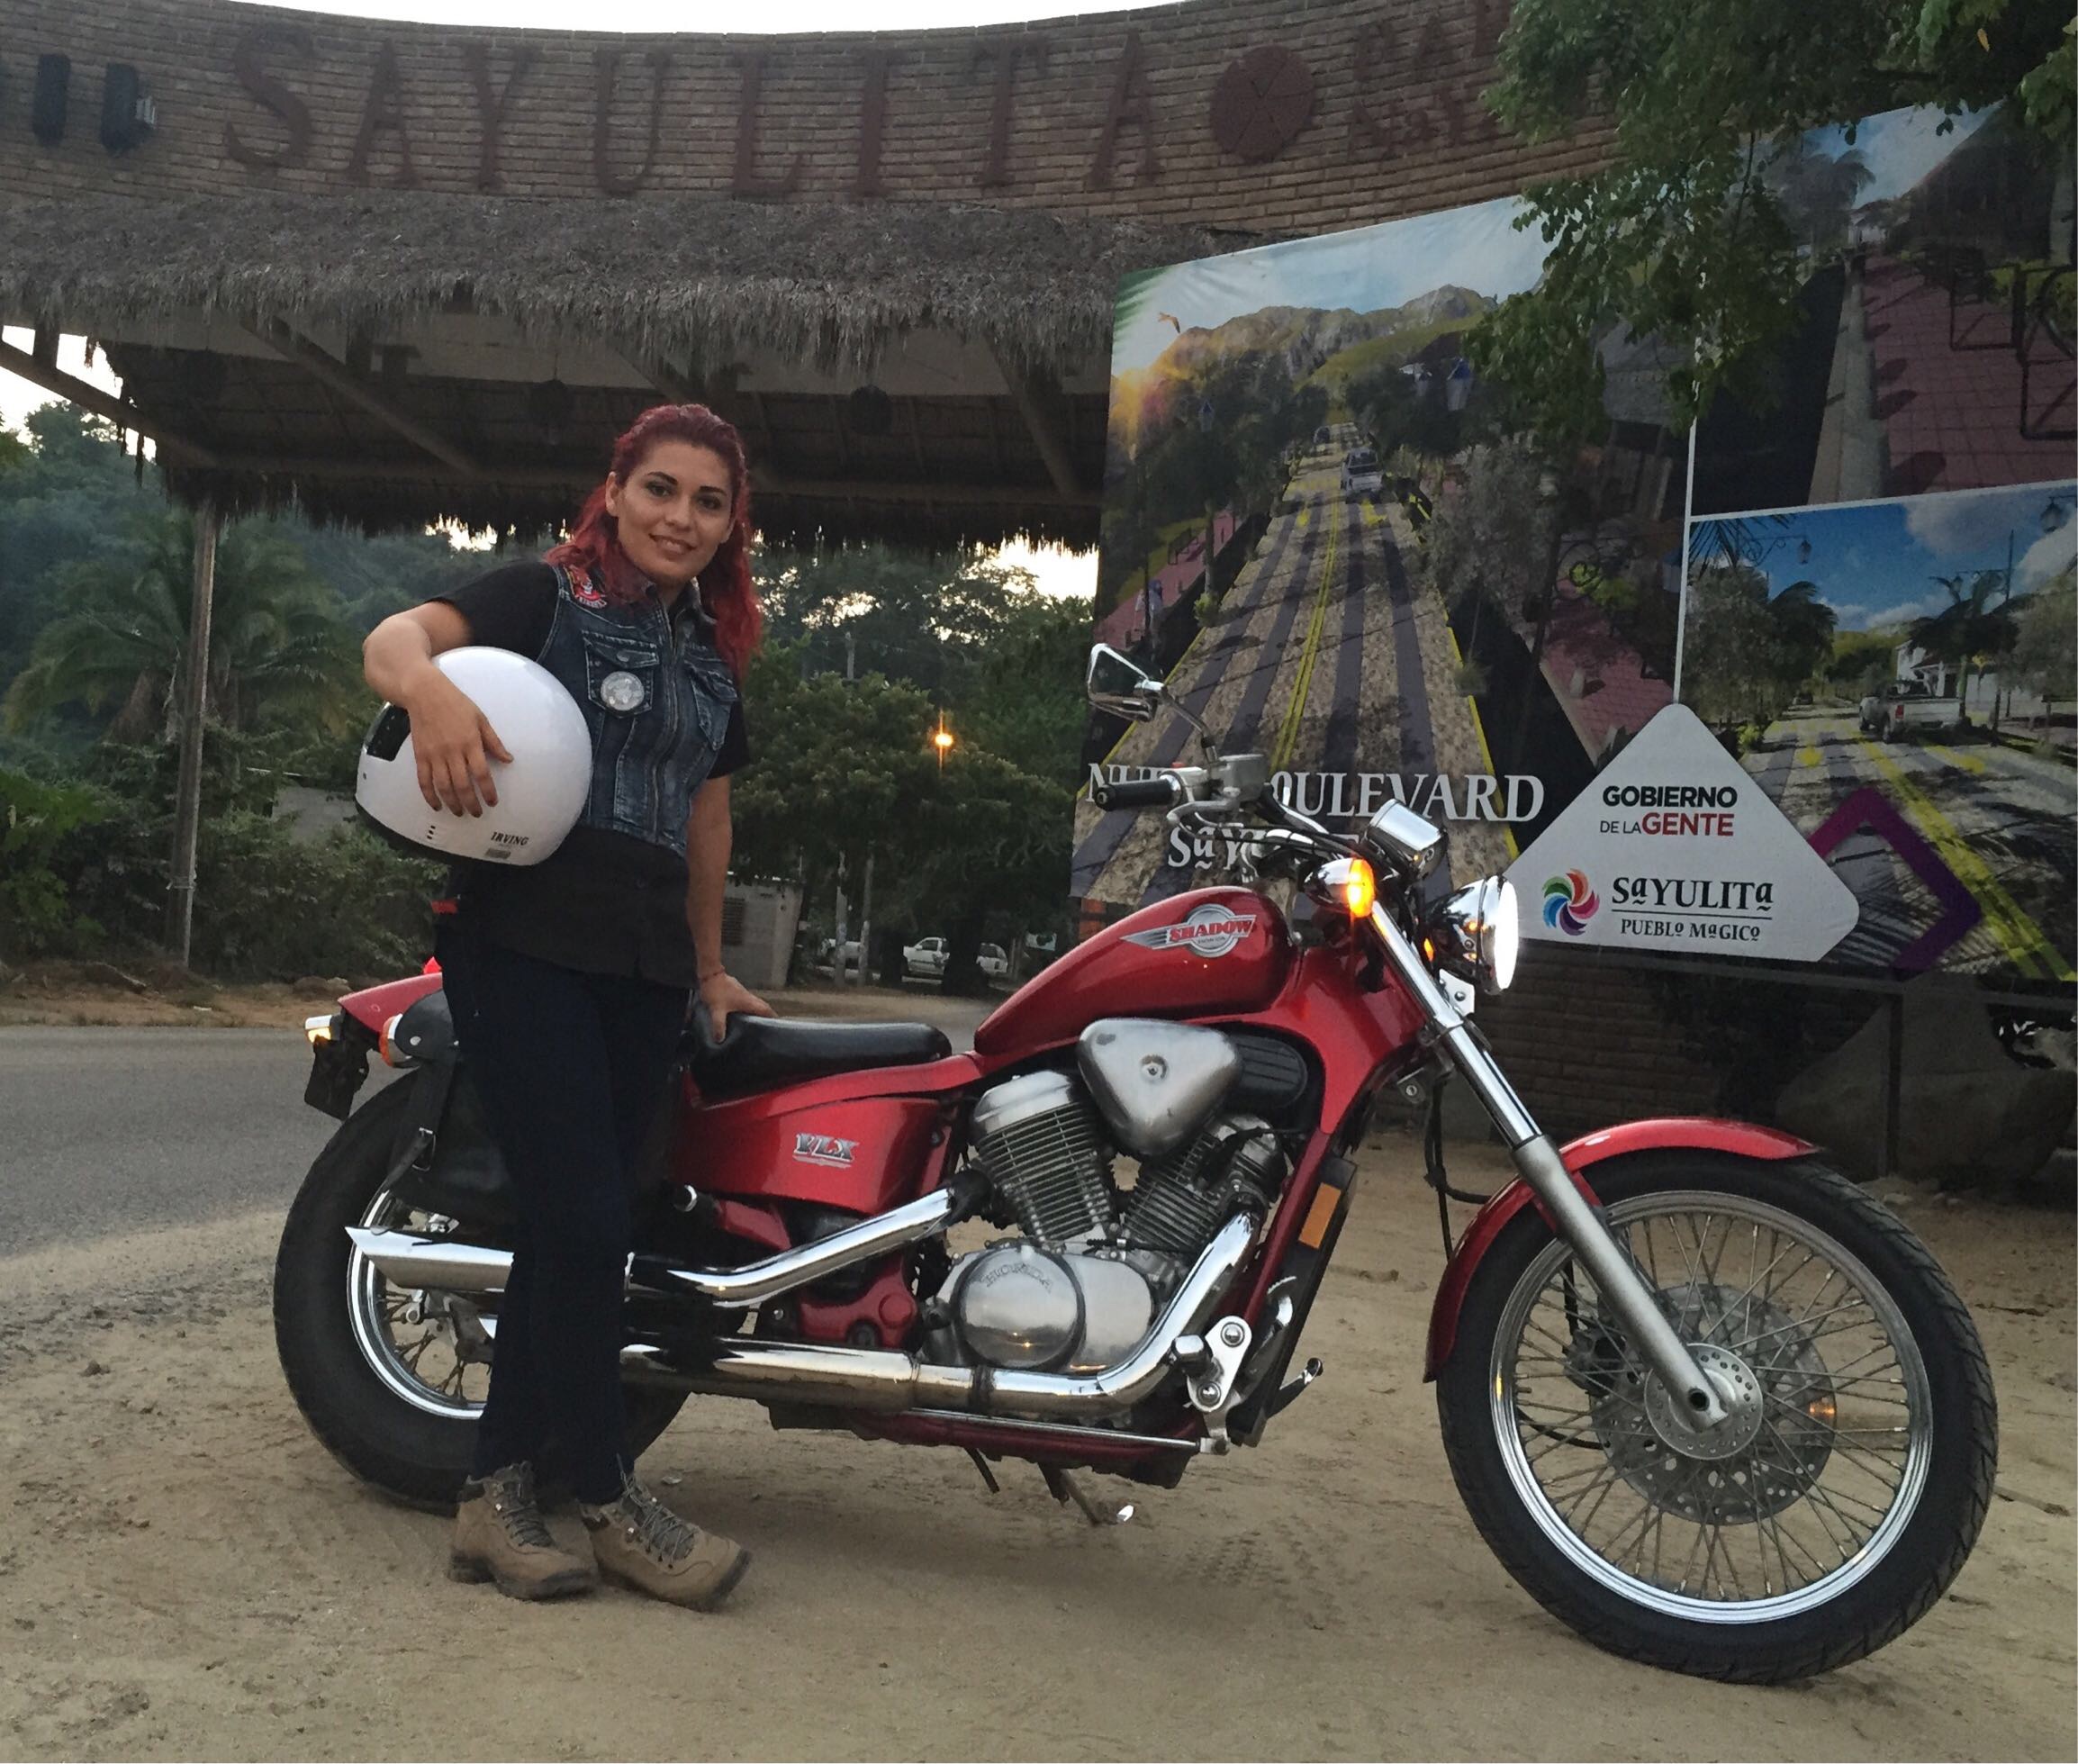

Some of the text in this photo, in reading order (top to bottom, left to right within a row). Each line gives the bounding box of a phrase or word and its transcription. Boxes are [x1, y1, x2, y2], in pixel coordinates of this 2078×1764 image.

[226, 18, 1163, 198] SAYULITA
[1269, 770, 1545, 822] OULEVARD
[1603, 784, 1739, 809] GOBIERNO
[1600, 811, 1735, 837] DE LA GENTE
[491, 831, 529, 846] IRVING
[1170, 919, 1253, 943] SHADOW
[793, 1132, 860, 1165] VLX
